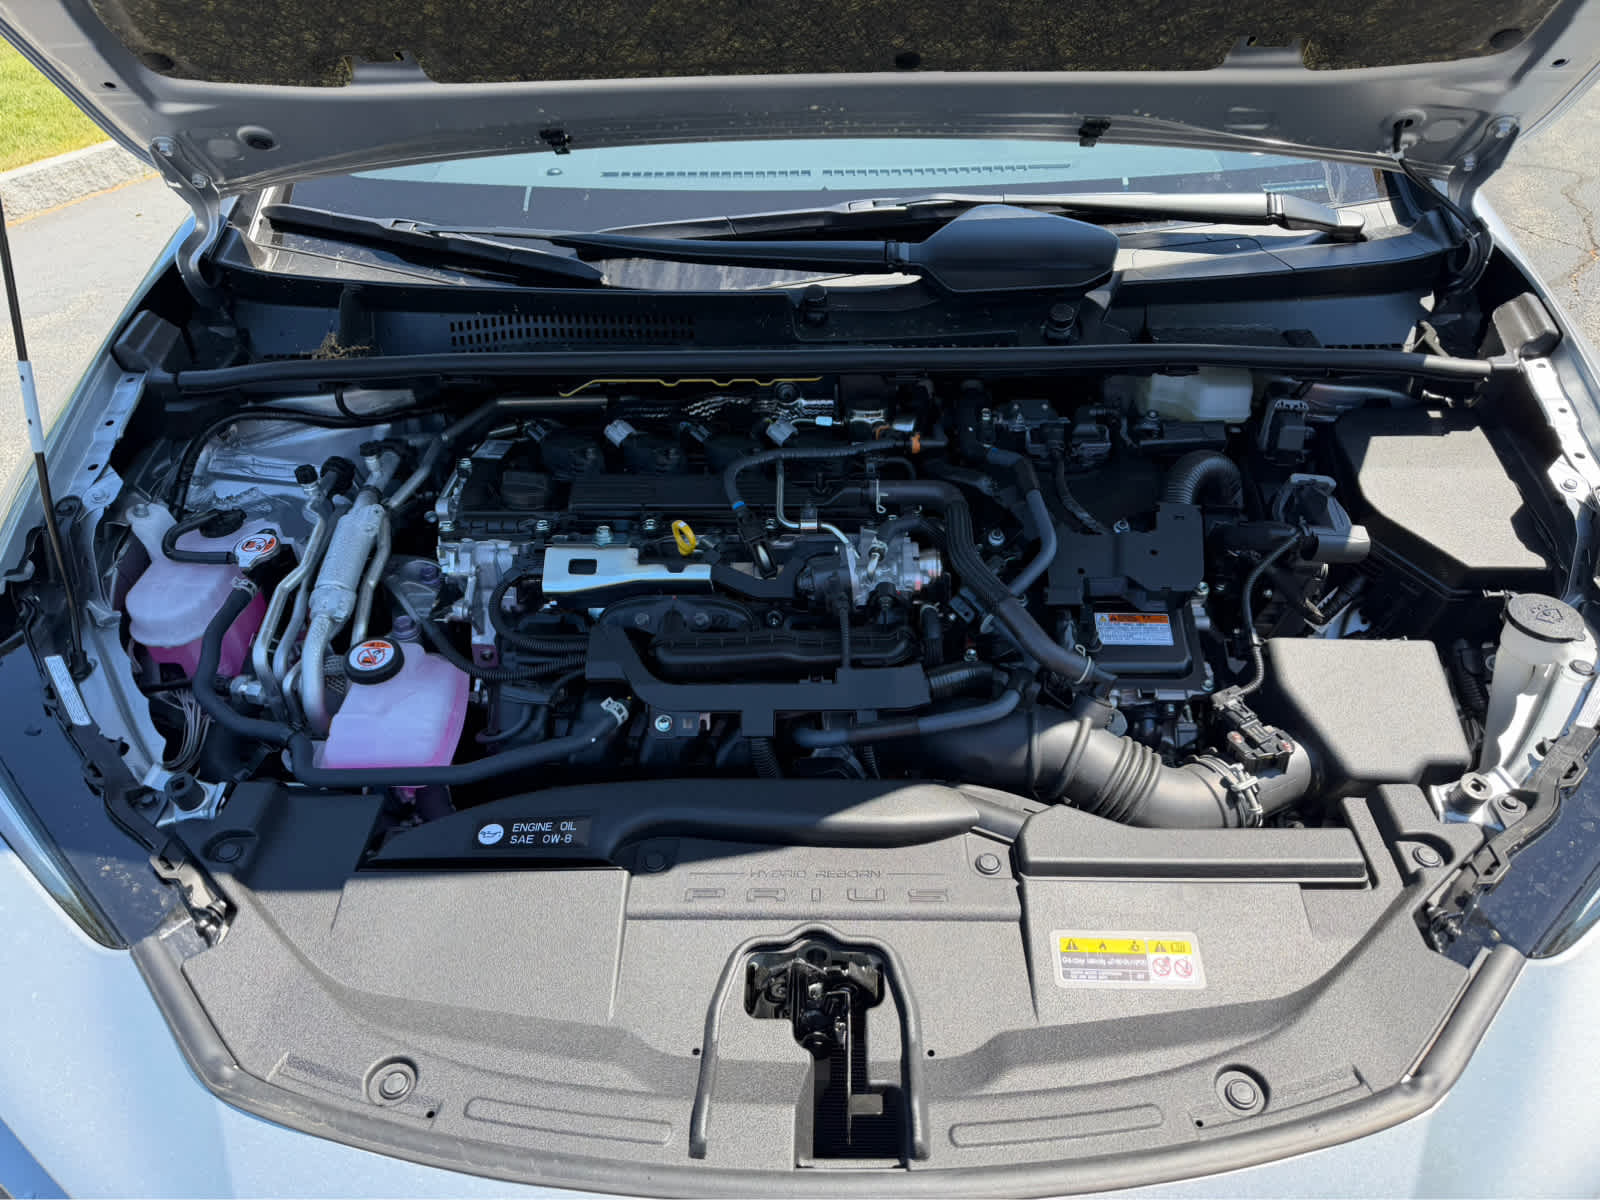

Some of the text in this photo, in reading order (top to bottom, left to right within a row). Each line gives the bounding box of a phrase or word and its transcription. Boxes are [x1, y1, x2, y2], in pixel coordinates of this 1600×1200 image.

[512, 821, 576, 833] ENGINE OIL
[510, 833, 572, 844] SAE 0W-8
[750, 870, 881, 879] HYBRID REBORN
[684, 887, 949, 902] PRIUS
